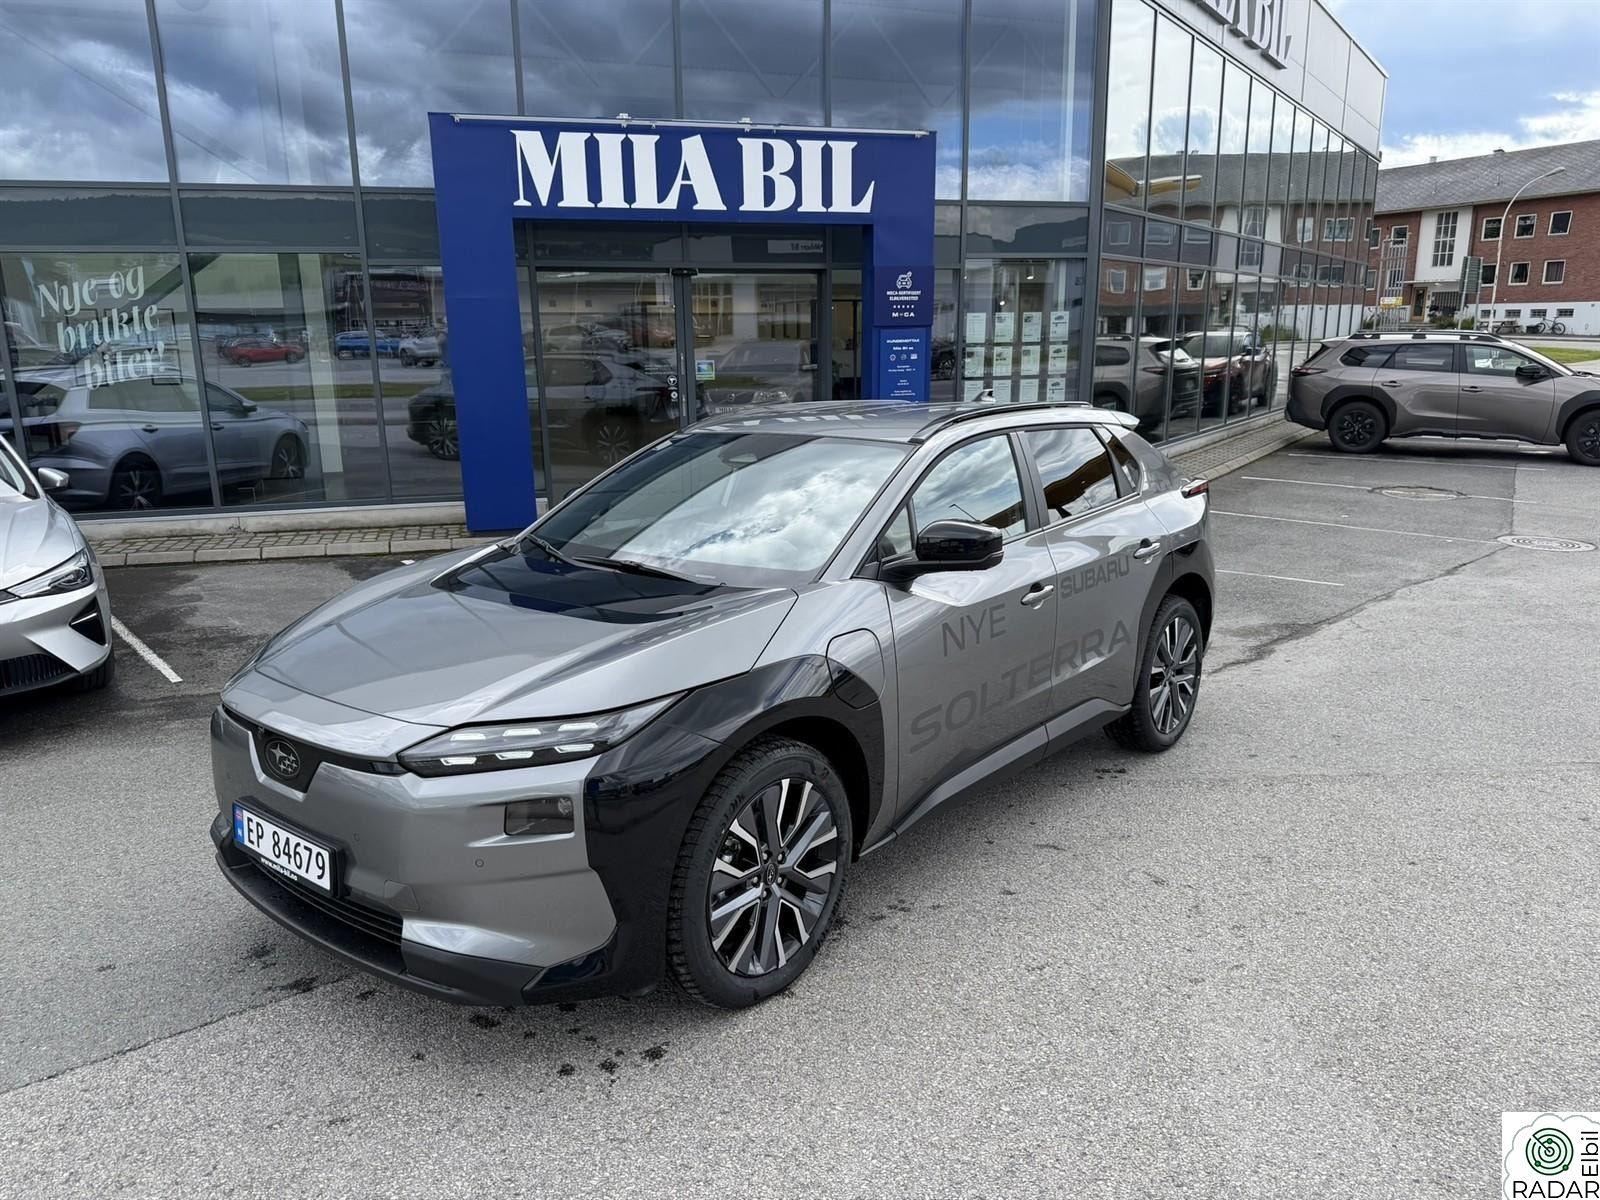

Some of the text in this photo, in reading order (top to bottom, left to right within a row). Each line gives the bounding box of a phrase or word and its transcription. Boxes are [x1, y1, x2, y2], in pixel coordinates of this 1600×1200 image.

[510, 129, 875, 213] MILA BIL
[38, 265, 145, 318] Nye og
[56, 304, 160, 354] brukte
[84, 341, 165, 390] biler!
[1060, 556, 1131, 599] SUBARU
[942, 604, 1007, 657] NYE
[909, 619, 1132, 755] SOLTERRA
[247, 816, 326, 881] EP 84679
